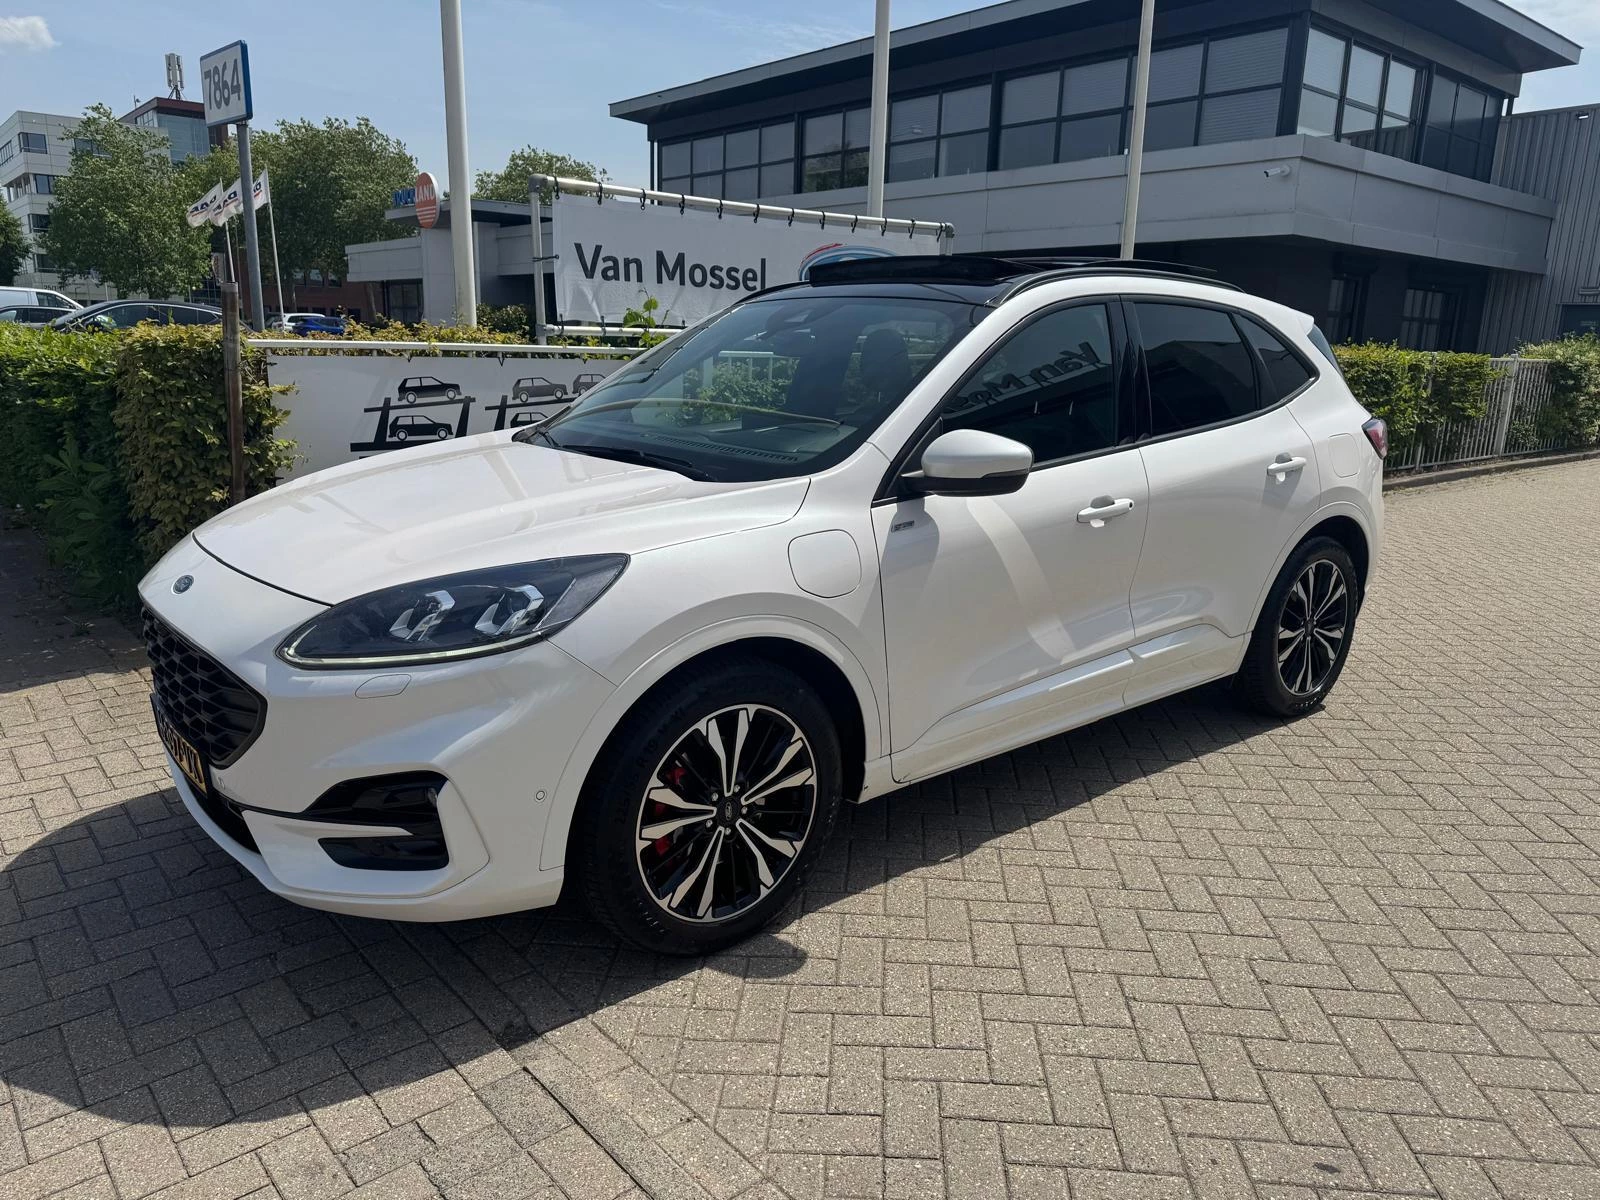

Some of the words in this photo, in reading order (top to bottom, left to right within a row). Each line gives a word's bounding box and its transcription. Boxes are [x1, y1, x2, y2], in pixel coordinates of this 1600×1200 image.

[204, 58, 241, 110] 7864
[574, 242, 643, 284] Van
[656, 250, 767, 292] Mossel
